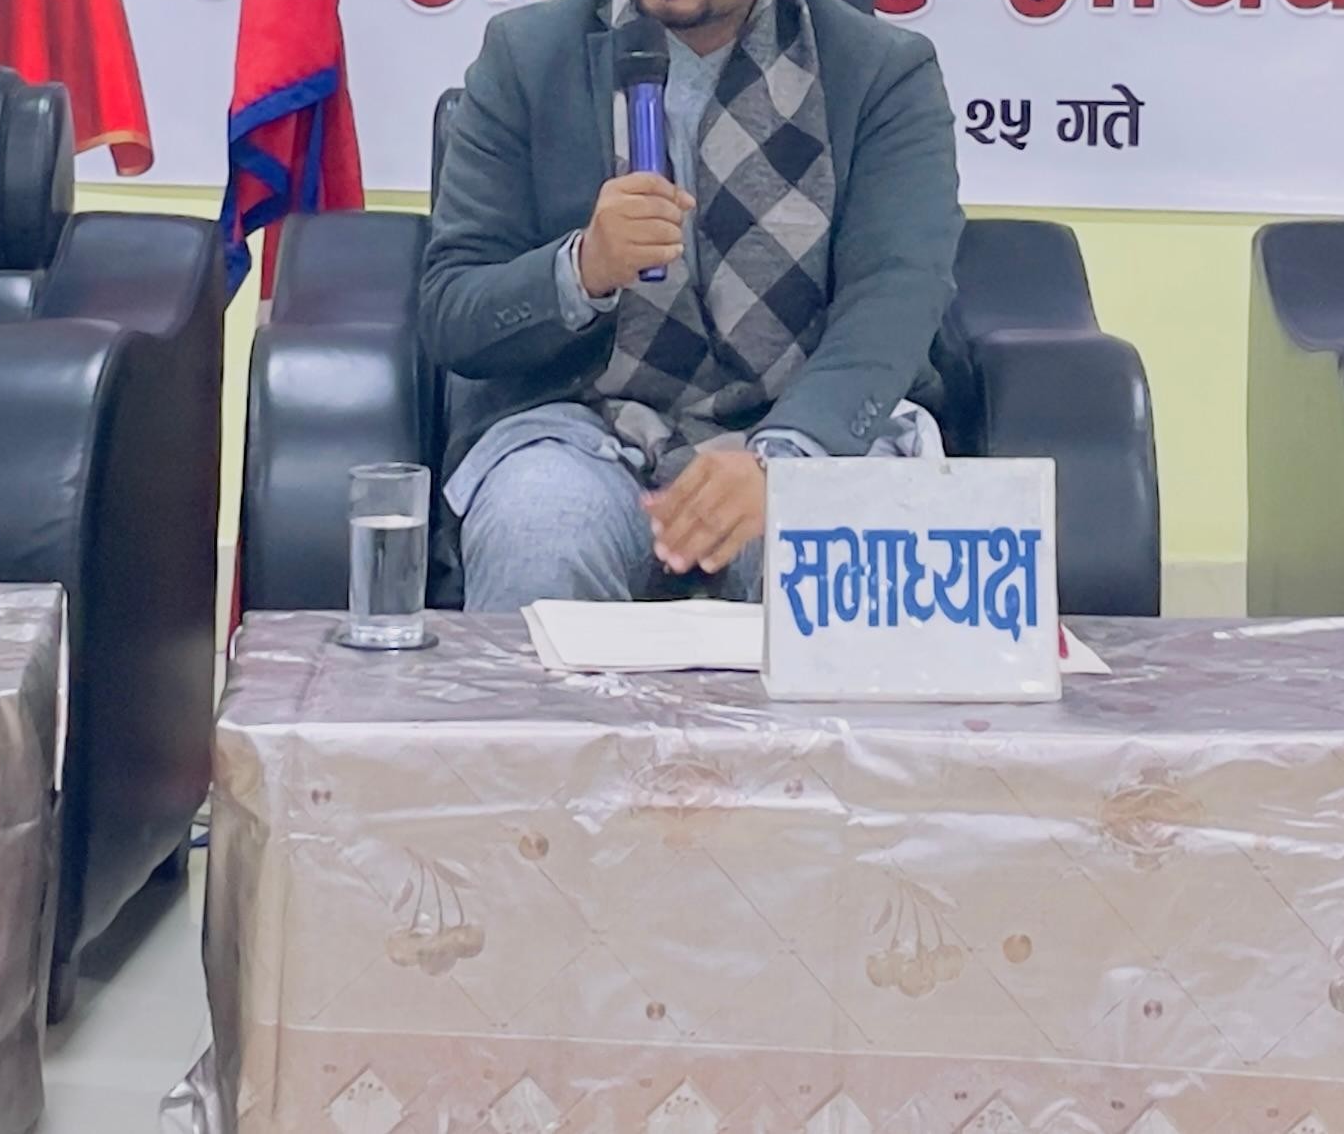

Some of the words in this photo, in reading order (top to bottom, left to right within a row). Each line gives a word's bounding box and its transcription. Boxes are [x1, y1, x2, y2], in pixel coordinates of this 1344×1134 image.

[964, 98, 1032, 151] २५
[1056, 83, 1145, 150] गते
[778, 526, 1042, 642] सभाध्यक्ष
